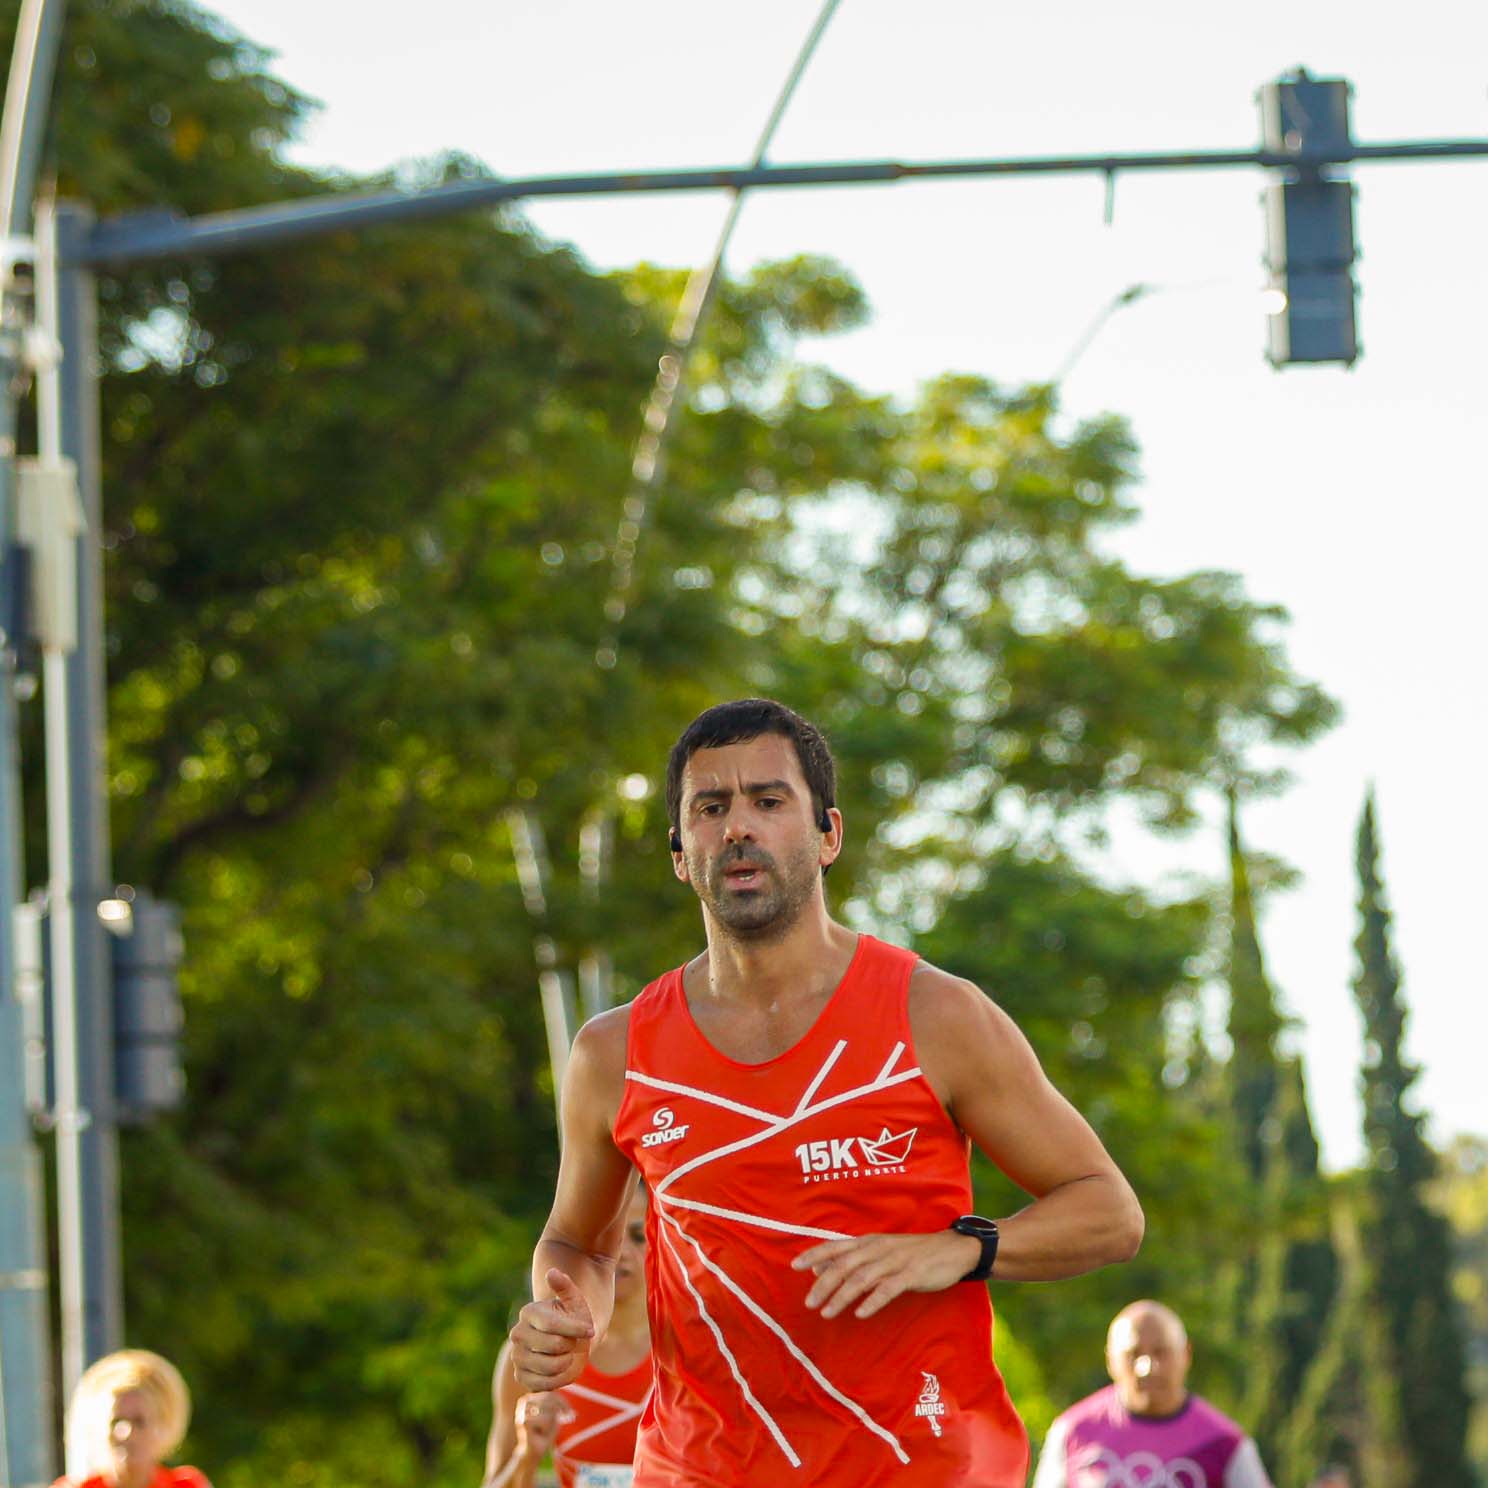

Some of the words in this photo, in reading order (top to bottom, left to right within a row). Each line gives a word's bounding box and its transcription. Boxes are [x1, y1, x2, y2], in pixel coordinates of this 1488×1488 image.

[795, 1137, 858, 1174] 15K
[803, 1170, 859, 1184] PUERTO
[864, 1164, 907, 1177] NORTE
[915, 1402, 945, 1417] ARDEC
